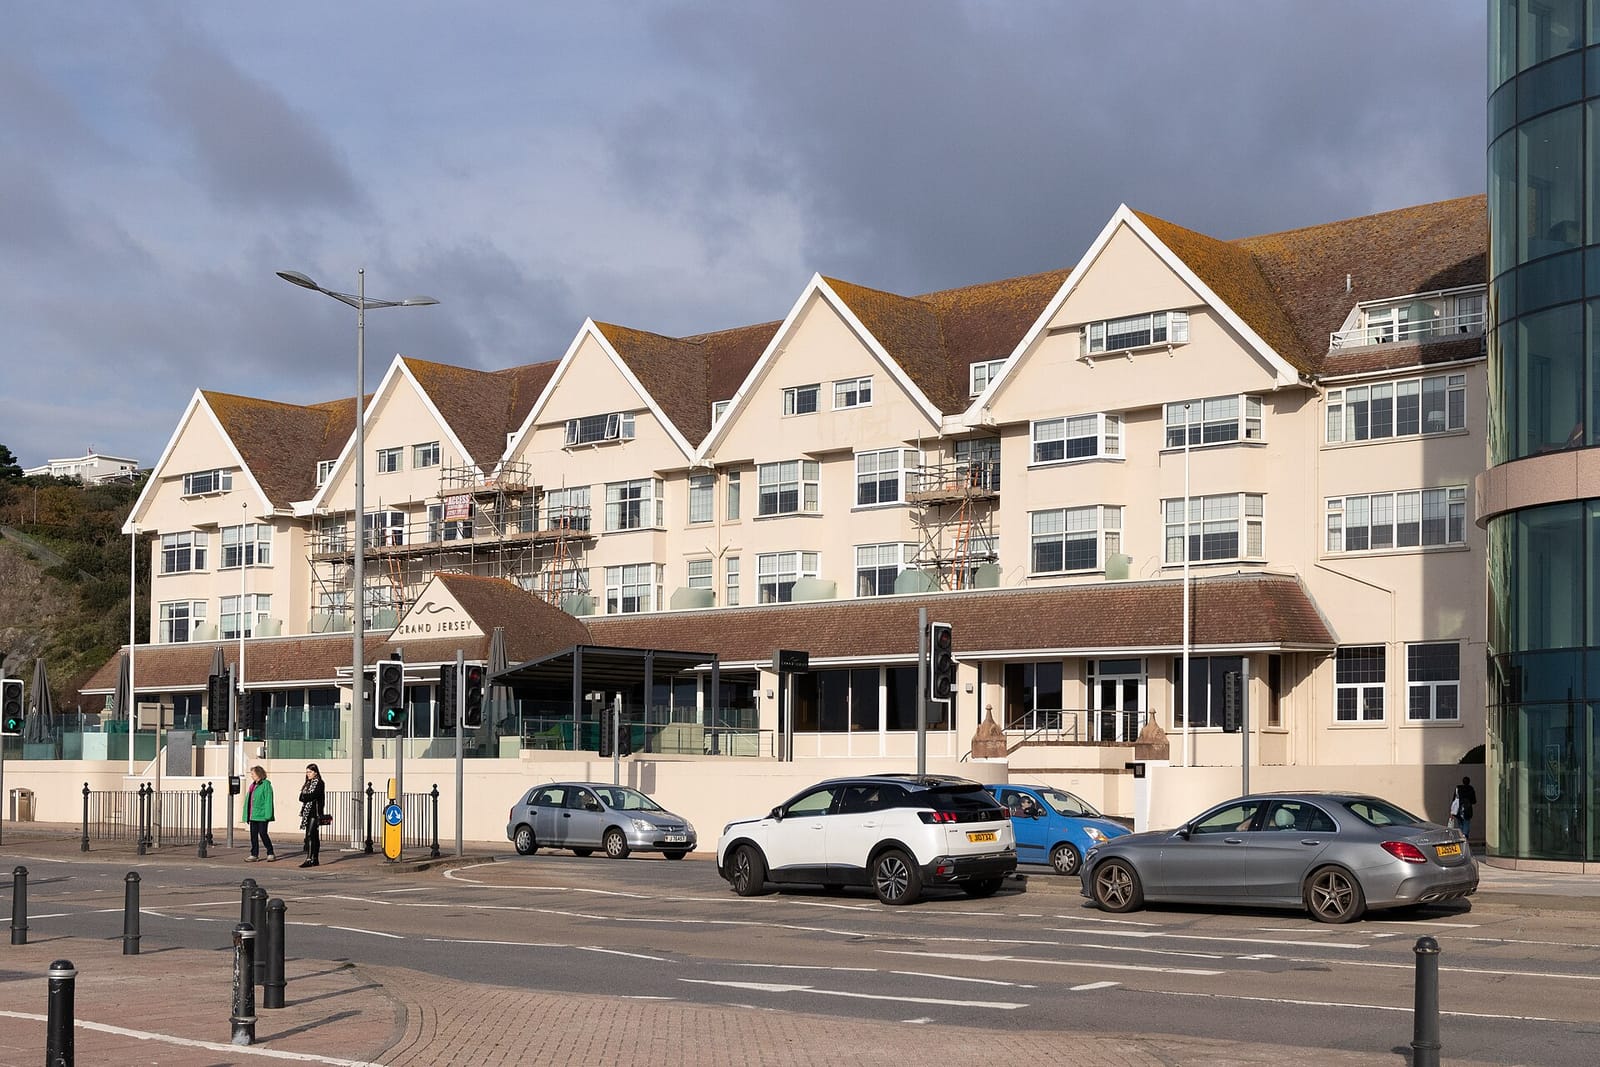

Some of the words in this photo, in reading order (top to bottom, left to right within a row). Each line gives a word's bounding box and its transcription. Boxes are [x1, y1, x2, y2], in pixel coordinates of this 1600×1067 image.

[448, 494, 469, 504] ACCESS
[398, 623, 432, 635] GRAND
[437, 620, 472, 632] JERSEY
